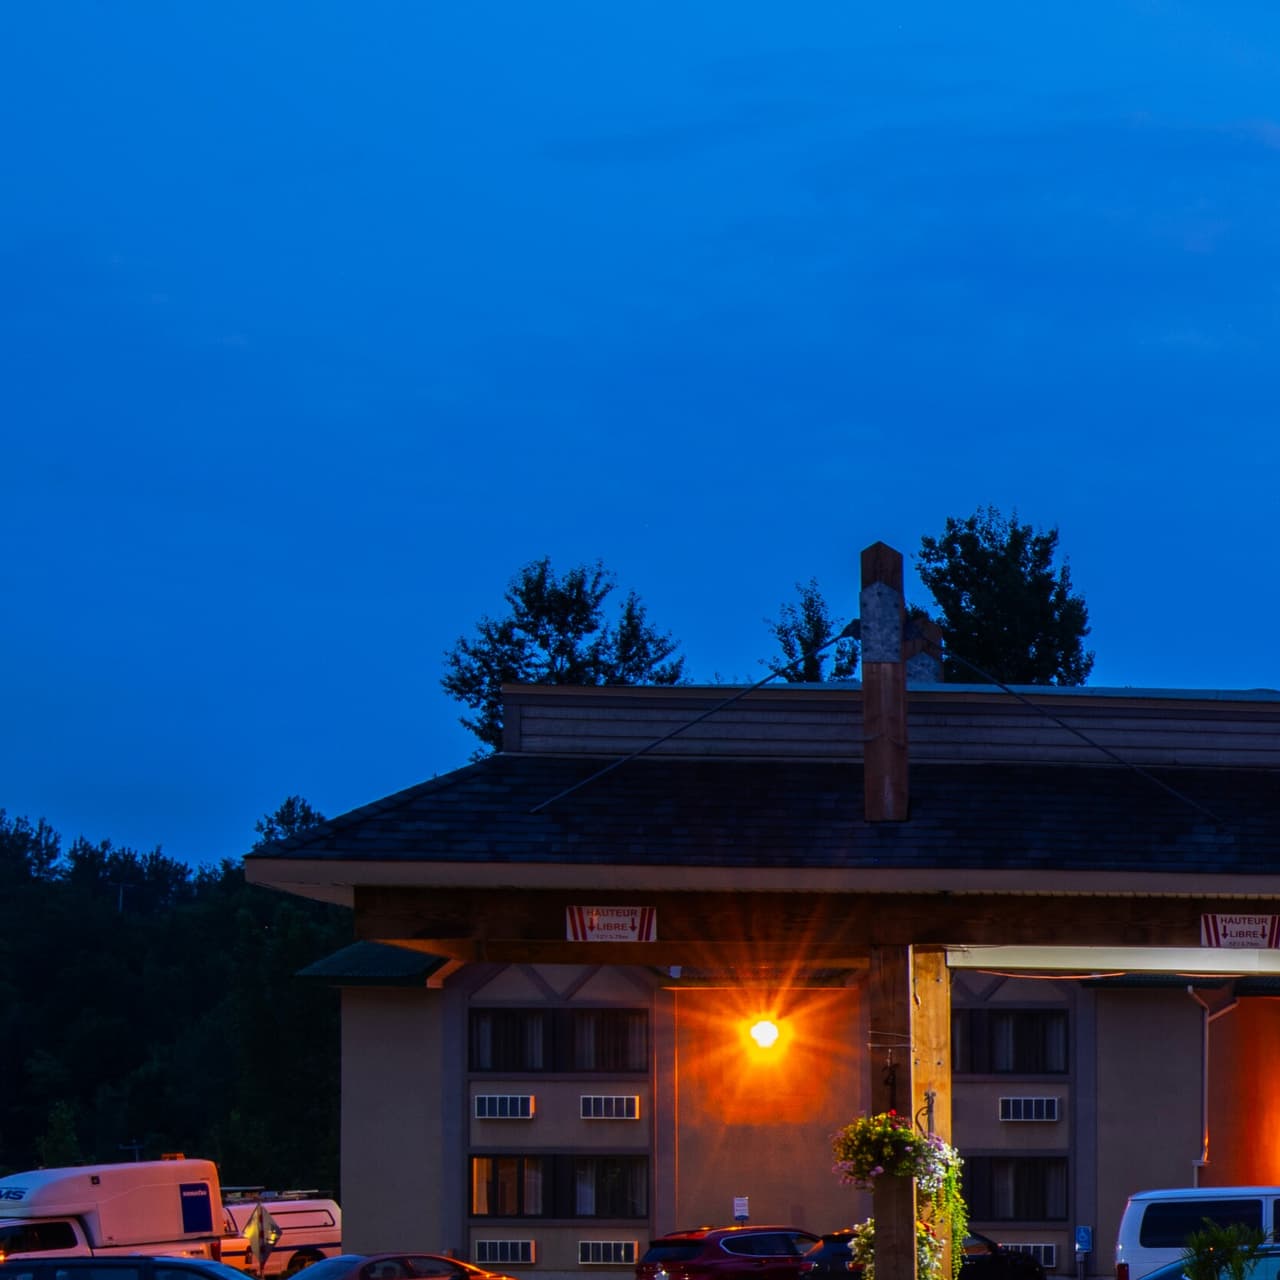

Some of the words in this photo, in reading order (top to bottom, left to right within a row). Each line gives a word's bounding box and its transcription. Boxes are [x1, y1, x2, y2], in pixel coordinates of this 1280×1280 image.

[586, 909, 638, 917] HAUTEUR
[1220, 917, 1268, 925] HAUTEUR
[596, 923, 628, 931] LIBRE
[1229, 930, 1259, 938] LIBRE
